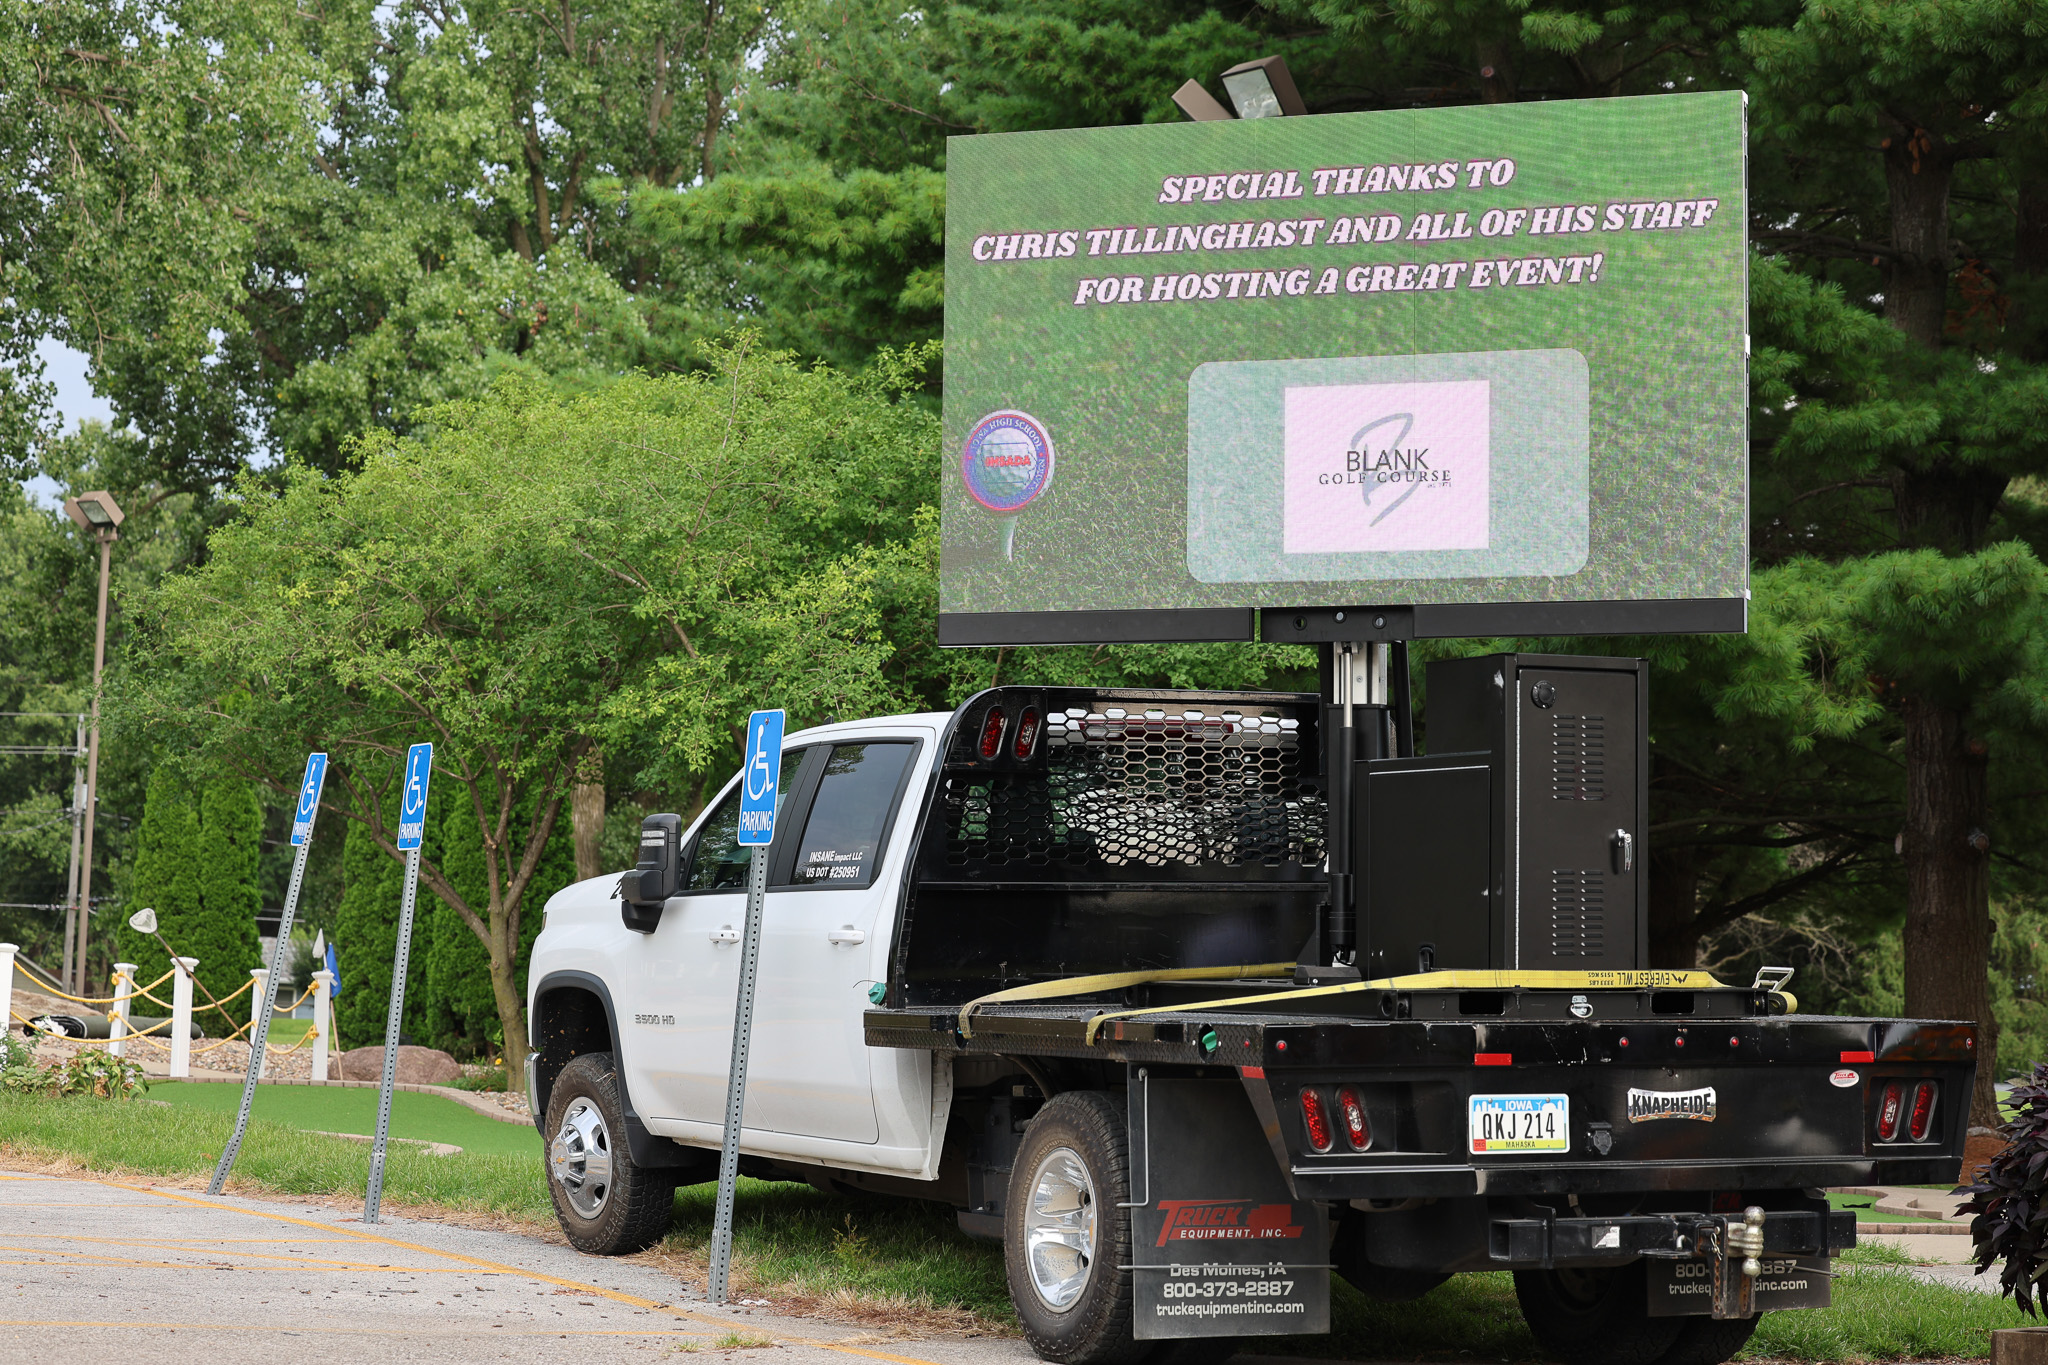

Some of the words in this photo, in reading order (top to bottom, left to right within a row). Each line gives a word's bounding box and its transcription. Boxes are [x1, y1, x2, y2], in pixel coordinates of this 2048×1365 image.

[1158, 171, 1304, 203] SPECIAL
[1311, 162, 1460, 196] THANKS
[1465, 158, 1516, 189] TO
[971, 230, 1080, 262] CHRIS
[1085, 218, 1326, 257] TILLINGHAST
[1326, 215, 1402, 245] AND
[1405, 212, 1474, 241] ALL
[1479, 208, 1528, 238] OF
[1527, 204, 1598, 235] HIS
[1601, 198, 1720, 232] STAFF
[1073, 276, 1145, 306] FOR
[1148, 267, 1312, 303] HOSTING
[1313, 266, 1341, 295] A
[1344, 260, 1468, 294] GREAT
[1467, 252, 1605, 289] EVENT!
[1014, 419, 1043, 448] SCHOOL
[1346, 448, 1430, 472] BLANK
[1318, 472, 1368, 485] GOLF
[1376, 469, 1452, 484] COURSE
[740, 810, 773, 832] PARKING
[400, 821, 422, 839] PARKING
[808, 851, 835, 863] INSANE
[834, 852, 852, 864] impact
[852, 851, 863, 861] LLC
[806, 867, 816, 878] US
[816, 867, 829, 877] DOT
[829, 865, 860, 879] #250951
[1617, 972, 1633, 986] WLL
[1634, 972, 1670, 986] EVEREST
[661, 1015, 676, 1025] HD
[1505, 1100, 1534, 1111] IOWA
[1631, 1091, 1713, 1117] KNAPHEIDE
[1482, 1112, 1516, 1140] QKJ
[1524, 1112, 1556, 1139] 214
[1505, 1141, 1536, 1149] MAHASKA
[1155, 1199, 1250, 1247] TRUCK
[1180, 1228, 1255, 1239] EQUIPMENT,
[1260, 1228, 1287, 1238] INC.
[1169, 1263, 1200, 1278] Des
[1203, 1262, 1266, 1279] Moines,
[1163, 1280, 1295, 1299] 800-373-2887
[1156, 1301, 1305, 1318] truckequipmentinc.com
